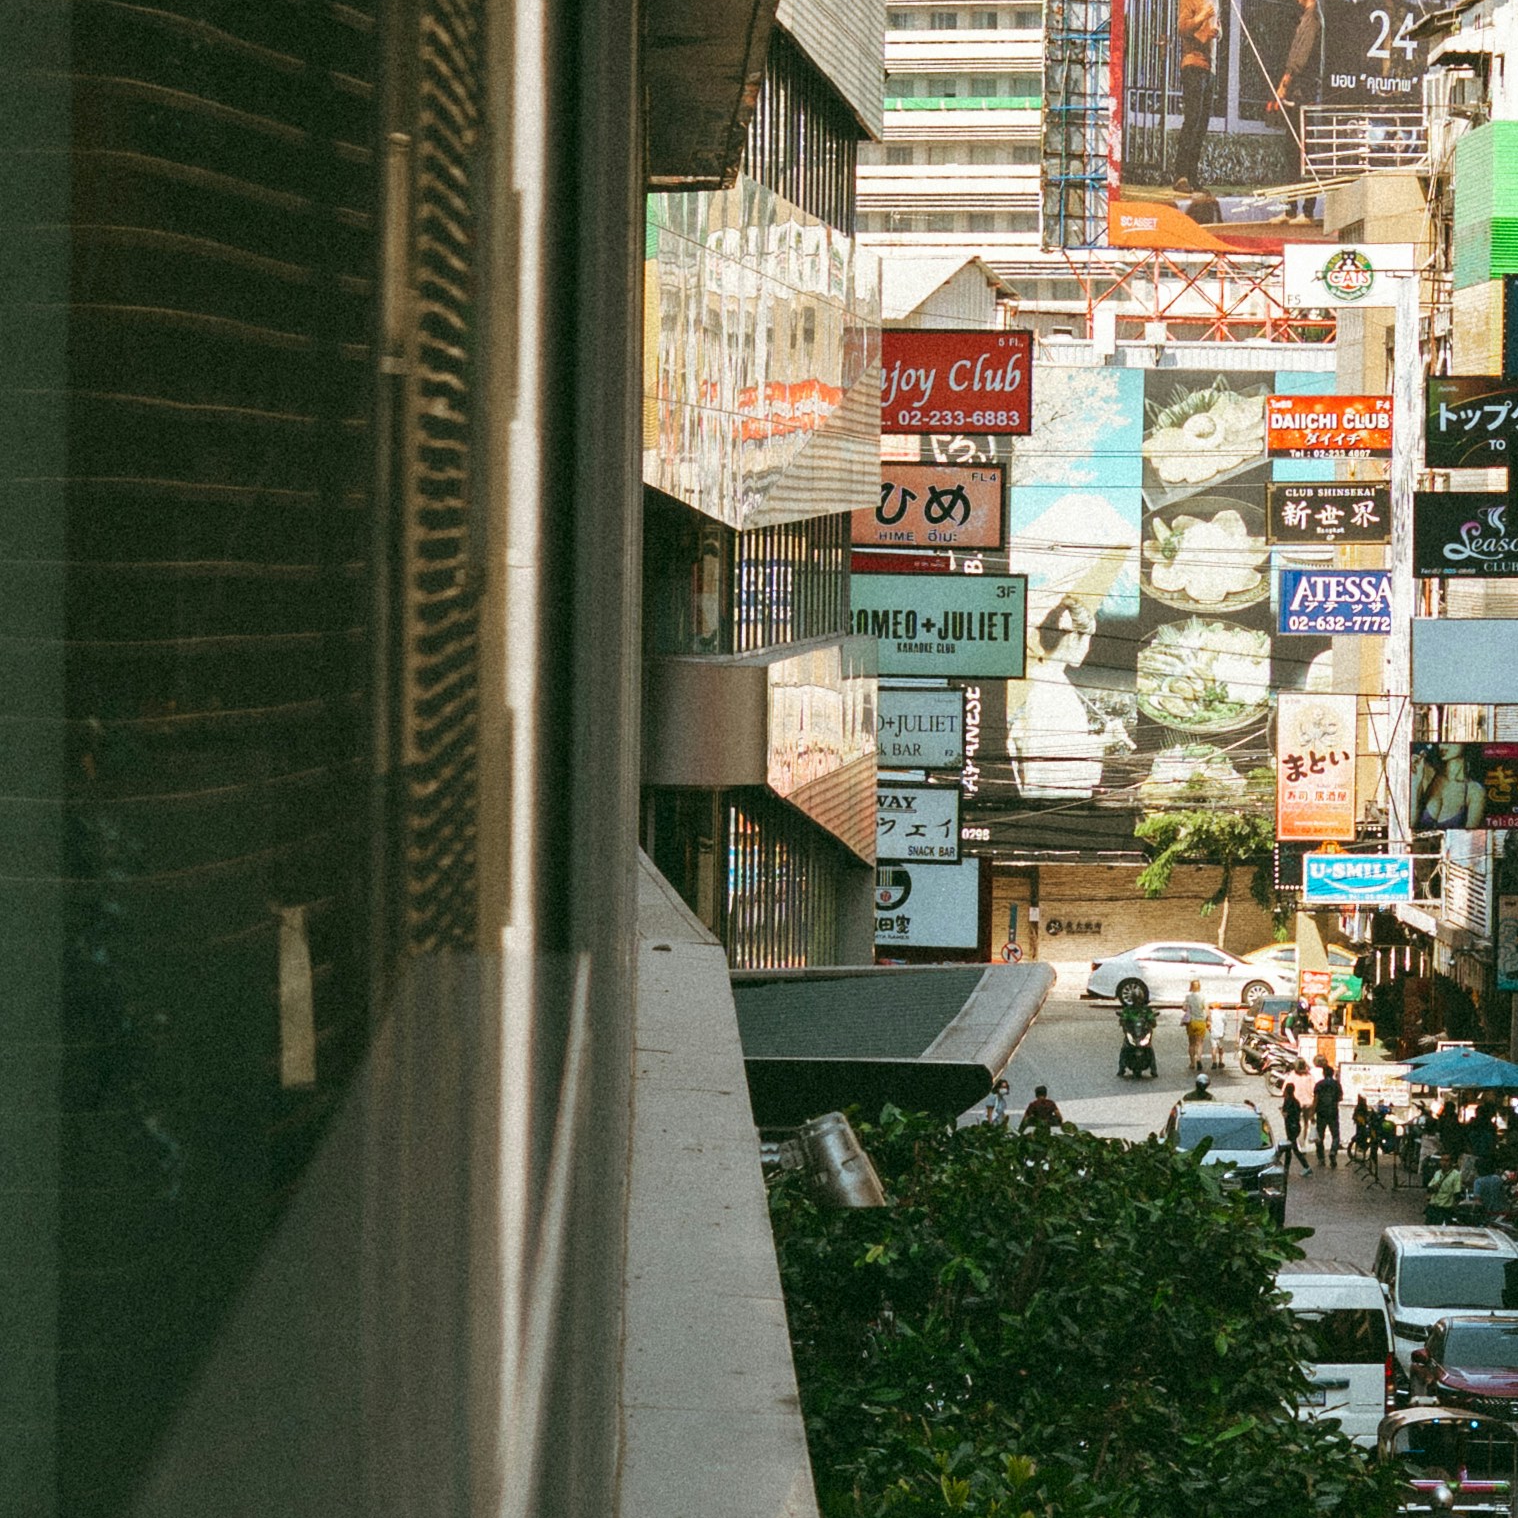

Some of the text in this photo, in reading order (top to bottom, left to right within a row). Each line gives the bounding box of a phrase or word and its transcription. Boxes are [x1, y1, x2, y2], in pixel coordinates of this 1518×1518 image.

[1367, 9, 1418, 60] 24
[1331, 74, 1355, 88] มอบ
[1329, 270, 1369, 284] CATS
[1287, 295, 1301, 305] F5
[880, 353, 1022, 408] joy Club
[1376, 401, 1390, 410] F4
[898, 410, 1020, 427] 02-233-6883
[1271, 413, 1389, 429] DAIICHI CLUB
[1285, 488, 1375, 497] CLUB SHINSEKAI
[875, 482, 971, 527] ひめ
[1282, 500, 1380, 530] 新世界
[879, 532, 914, 542] HIME
[996, 585, 1016, 599] 3F
[1290, 576, 1393, 611] ATESSA
[1289, 615, 1391, 631] 02-632-7772
[897, 642, 956, 654] KARAOKE CLUB
[892, 743, 922, 756] BAR
[1282, 750, 1350, 782] まとい
[908, 845, 955, 857] SNACK BAR
